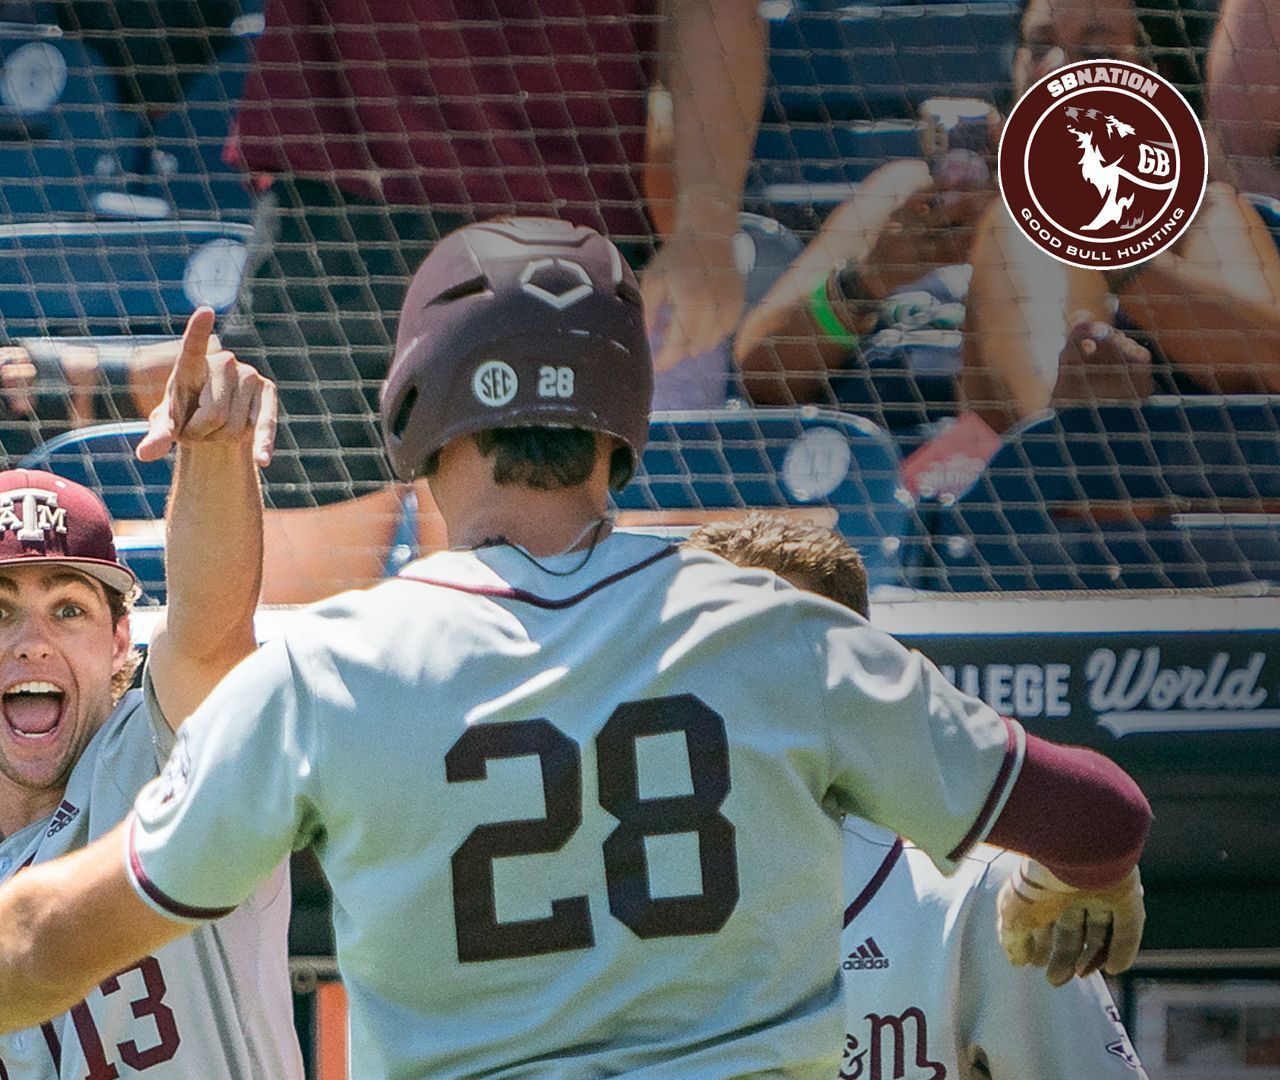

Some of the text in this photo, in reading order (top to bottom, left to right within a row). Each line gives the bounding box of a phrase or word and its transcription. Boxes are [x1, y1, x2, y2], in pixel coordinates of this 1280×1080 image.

[480, 367, 512, 401] SEC
[538, 366, 575, 399] 28
[1085, 647, 1269, 712] World
[444, 693, 741, 964] 28
[842, 957, 890, 971] adidas
